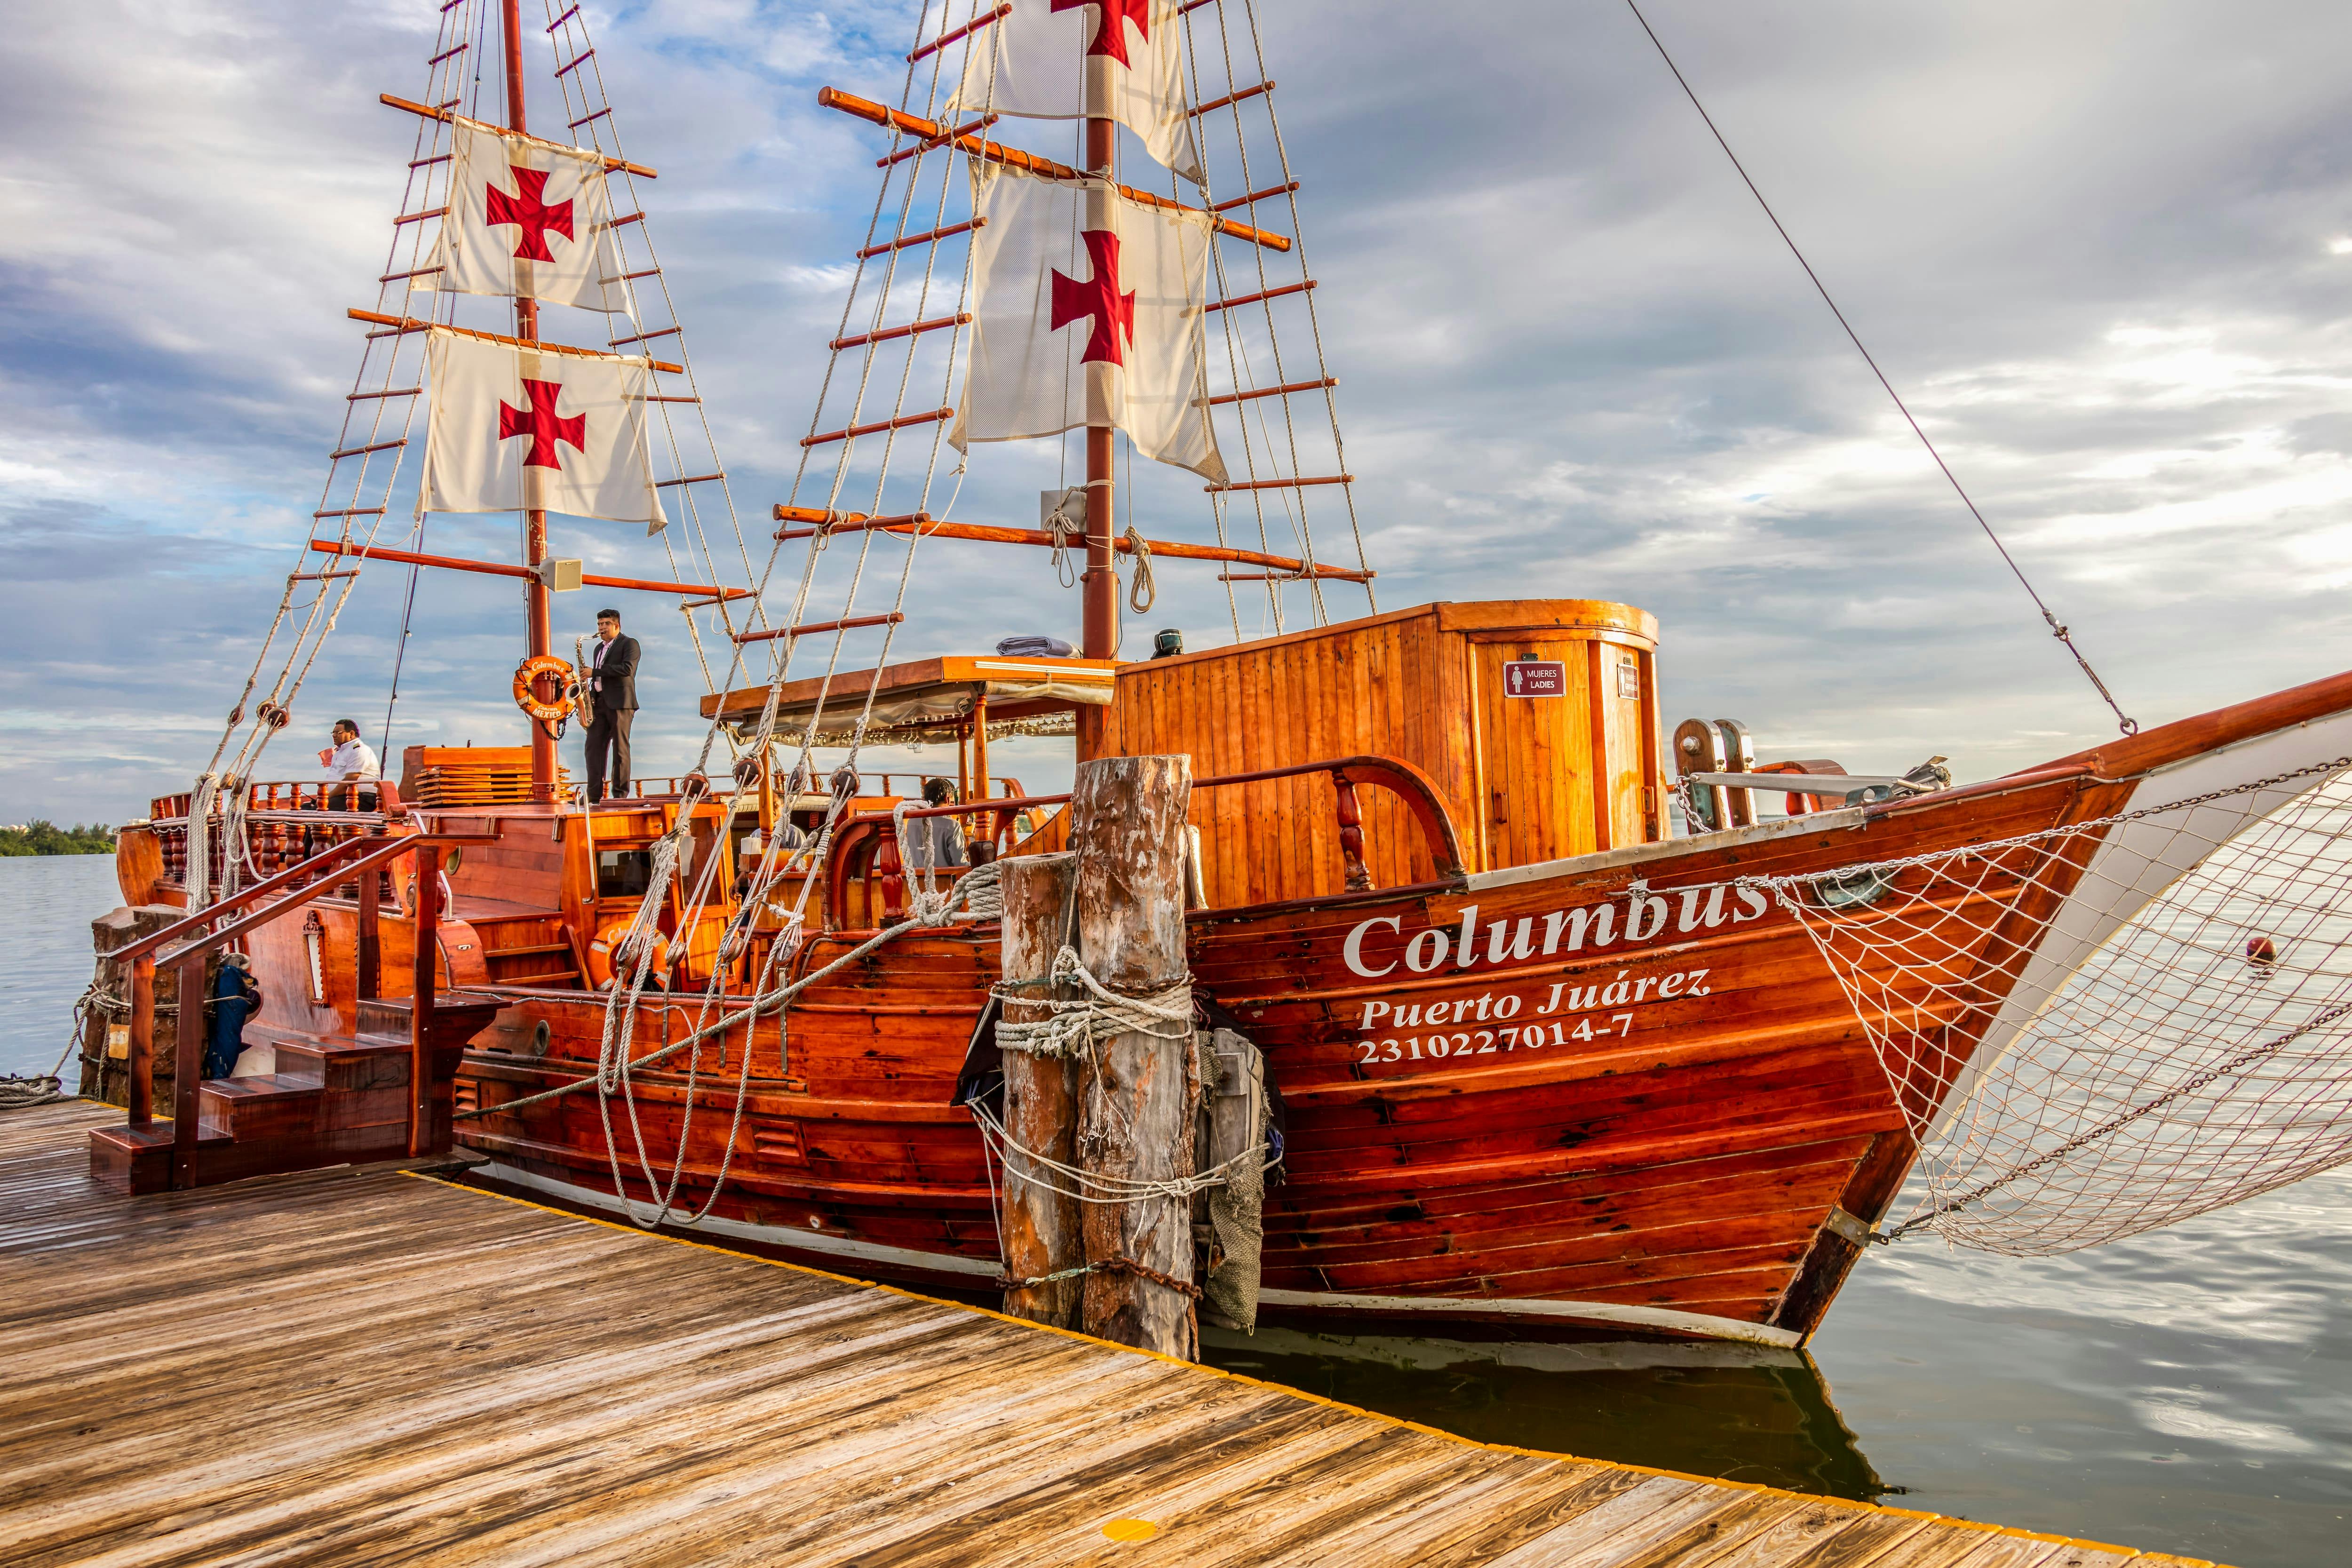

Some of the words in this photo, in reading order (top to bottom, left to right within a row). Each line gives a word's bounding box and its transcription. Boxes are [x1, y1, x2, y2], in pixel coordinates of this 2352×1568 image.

[532, 661, 564, 672] Columbus
[1527, 669, 1557, 678] MUJERES
[532, 708, 561, 718] MEXICO
[1343, 874, 1769, 977] Columbus
[1358, 991, 1521, 1030] Puerto
[1537, 969, 1710, 1014] Juárez
[1359, 1012, 1634, 1063] 2310227014-7
